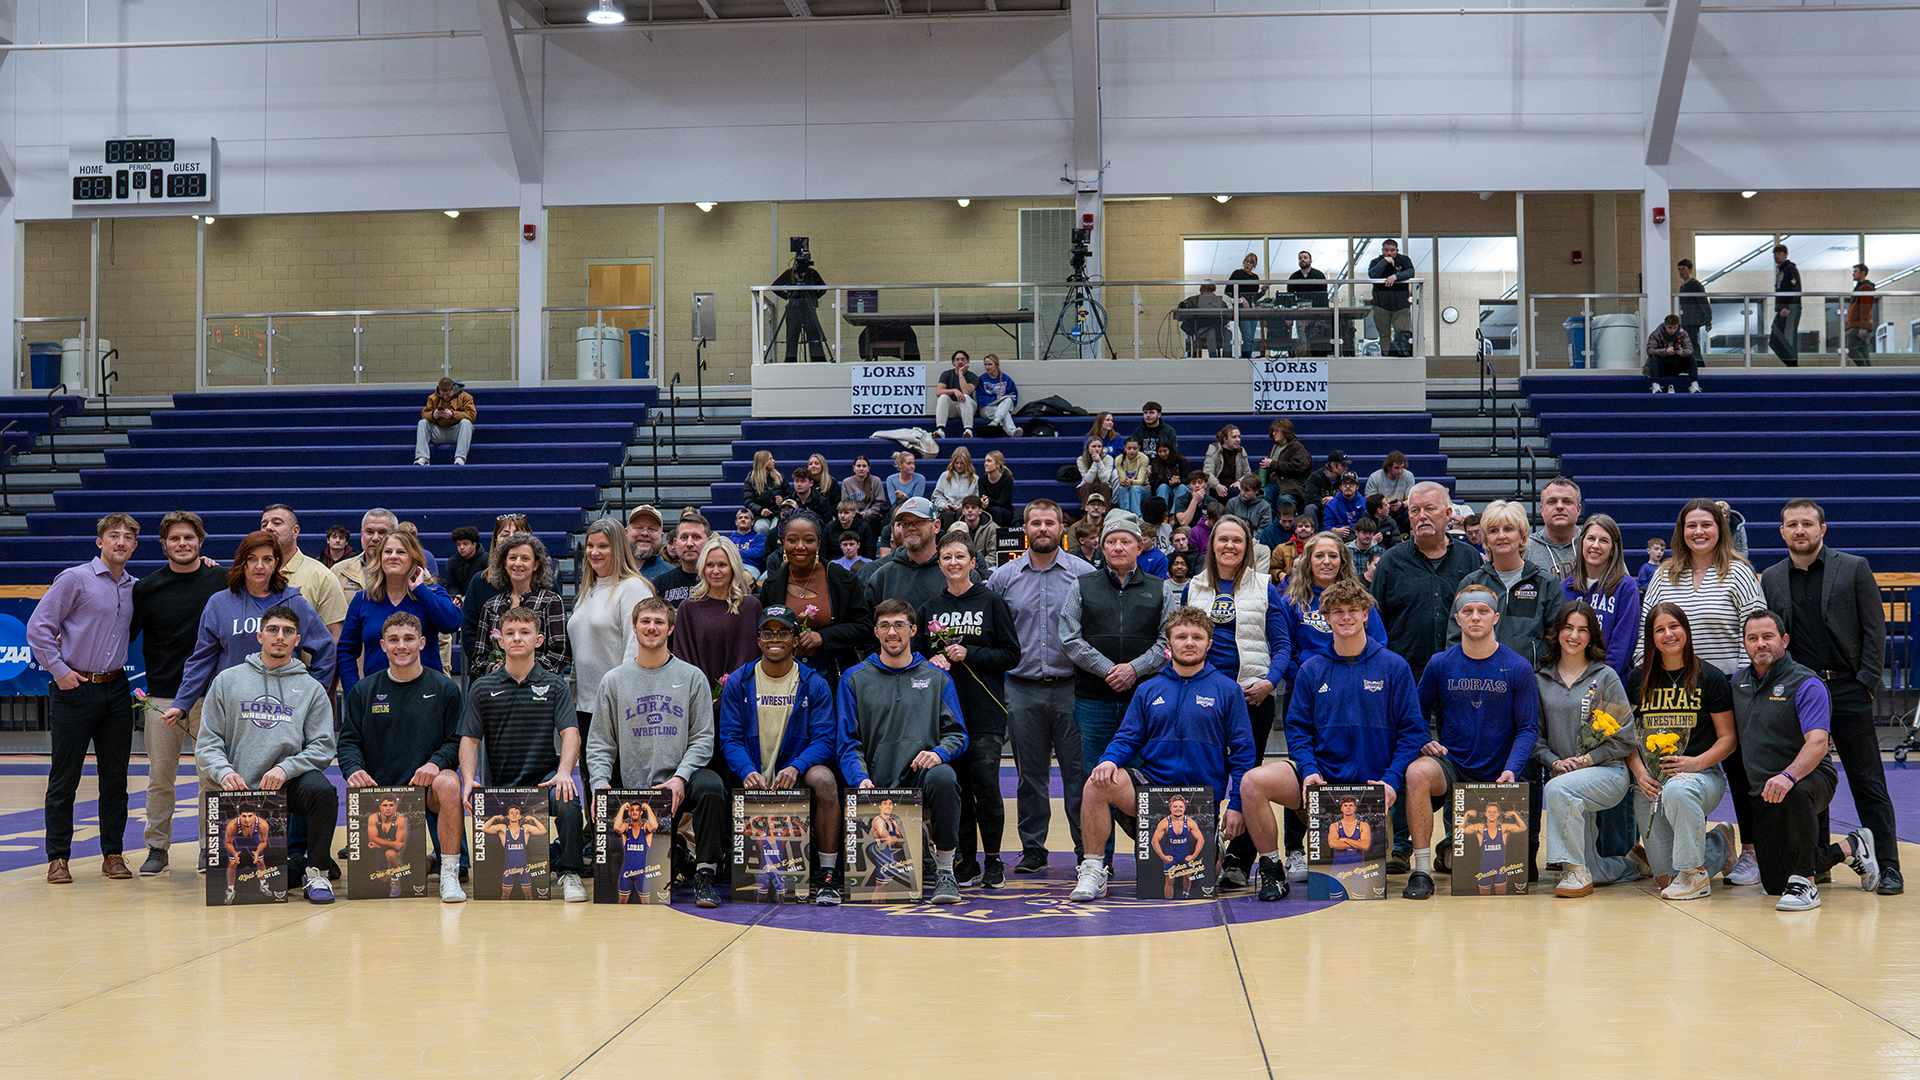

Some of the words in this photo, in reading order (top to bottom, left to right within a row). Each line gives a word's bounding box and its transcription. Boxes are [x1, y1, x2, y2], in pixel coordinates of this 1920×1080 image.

[80, 165, 103, 174] HOME
[173, 163, 200, 172] GUEST
[862, 366, 915, 377] LORAS
[1264, 362, 1317, 373] LORAS
[852, 385, 925, 396] STUDENT
[1254, 381, 1328, 392] STUDENT
[853, 404, 924, 415] SECTION
[1254, 400, 1327, 411] SECTION
[999, 538, 1019, 547] MATCH
[232, 616, 262, 636] LO
[0, 646, 31, 663] AA
[1447, 678, 1507, 693] LORAS
[1640, 687, 1702, 712] LORAS
[239, 702, 294, 717] LORAS
[241, 713, 292, 722] WRESTLING
[625, 701, 684, 721] LORAS
[1645, 715, 1694, 727] WRESTLING
[350, 793, 359, 816] 2026
[475, 793, 484, 815] 2026
[597, 795, 607, 817] 2026
[734, 795, 744, 818] 2026
[847, 795, 857, 817] 2026
[1140, 792, 1149, 815] 2026
[1309, 792, 1319, 814] 2026
[1456, 789, 1465, 811] 2026
[209, 797, 219, 820] 2026
[208, 820, 219, 835] OF
[350, 818, 359, 830] OF
[476, 818, 485, 830] OF
[597, 818, 607, 832] OF
[734, 820, 744, 832] OF
[847, 819, 856, 831] OF
[1140, 816, 1149, 828] OF
[1310, 816, 1319, 829] OF
[1455, 813, 1464, 826] OF
[350, 832, 360, 860] CLASS
[476, 831, 485, 861] CLASS
[596, 834, 606, 864] CLASS
[734, 834, 744, 864] CLASS
[847, 834, 856, 863] CLASS
[1140, 830, 1149, 859] CLASS
[1310, 831, 1320, 860] CLASS
[1454, 827, 1464, 856] CLASS
[209, 837, 219, 866] CLASS
